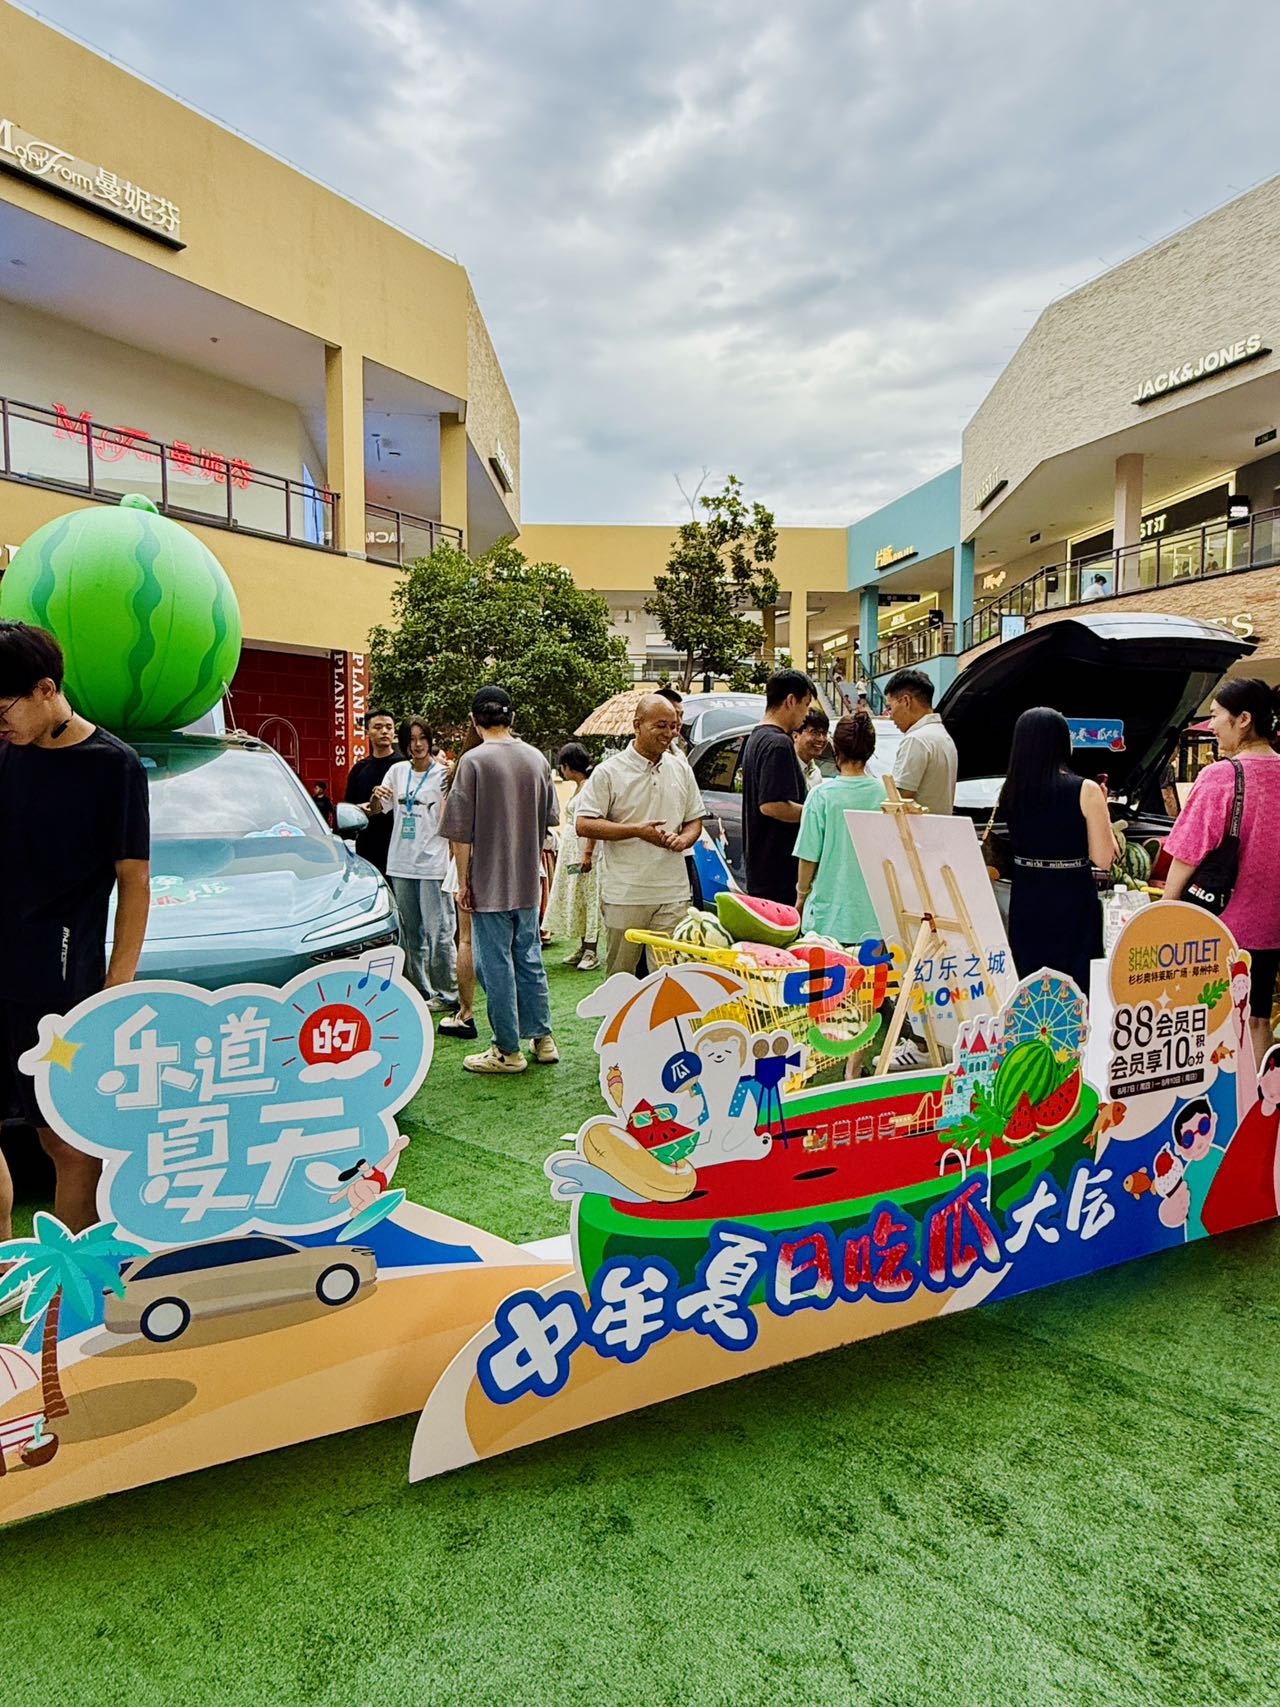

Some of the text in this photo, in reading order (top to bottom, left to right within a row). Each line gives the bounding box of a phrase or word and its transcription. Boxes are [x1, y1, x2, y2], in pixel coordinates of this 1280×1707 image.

[95, 168, 181, 232] 曼妮芬
[1133, 334, 1261, 400] JACK&JONES
[334, 653, 346, 767] PLANET 33
[352, 652, 366, 741] PLANET
[913, 951, 1006, 983] 幻乐之城
[1128, 944, 1159, 960] SHAN
[1128, 957, 1159, 972] SHAN
[1158, 938, 1221, 968] OUTLET
[671, 1058, 691, 1082] 瓜
[139, 1097, 365, 1224] 夏天
